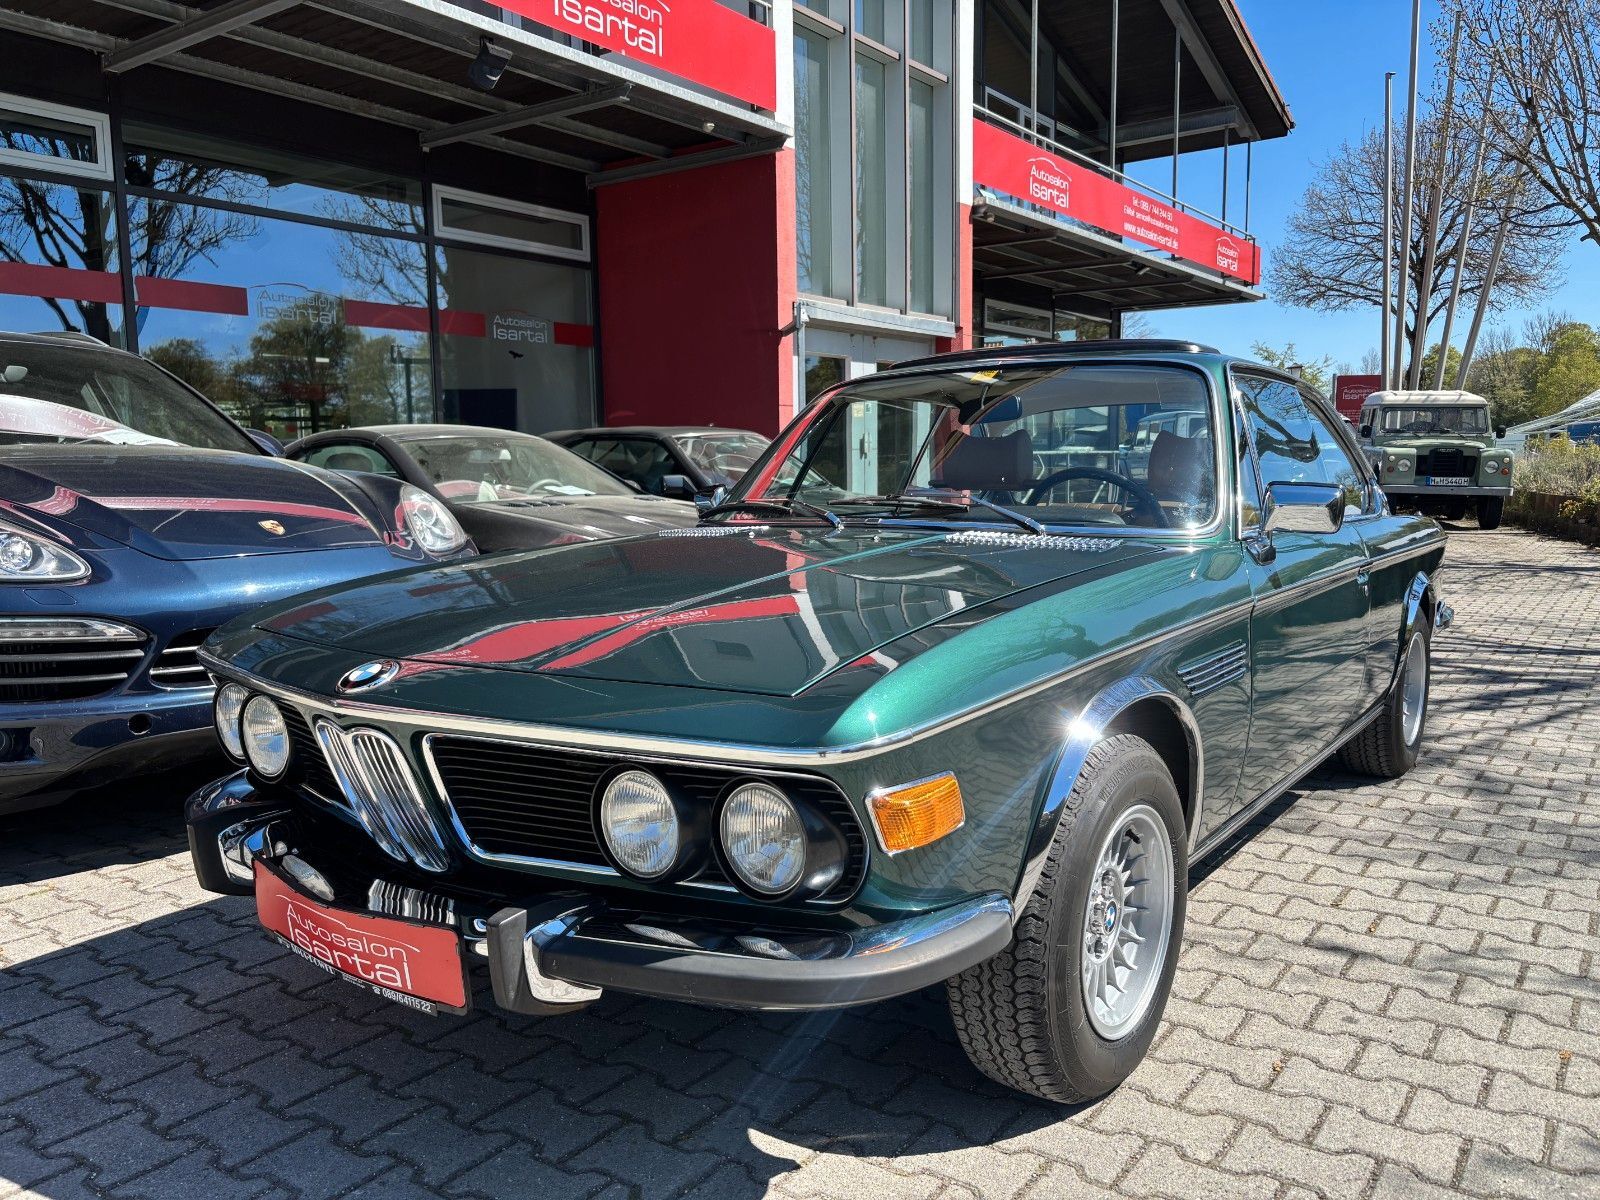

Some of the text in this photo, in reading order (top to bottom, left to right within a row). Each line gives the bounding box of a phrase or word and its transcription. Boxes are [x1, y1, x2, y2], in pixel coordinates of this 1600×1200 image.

[1030, 164, 1069, 191] Autosalon
[1029, 175, 1069, 209] Isartal
[1216, 242, 1239, 259] Autosalon
[1216, 249, 1238, 273] Isartal
[493, 314, 547, 329] Autosalon
[493, 324, 548, 344] Isartal
[1342, 391, 1368, 400] Isart
[286, 903, 408, 962] Autosalon
[287, 915, 414, 991] Isartal
